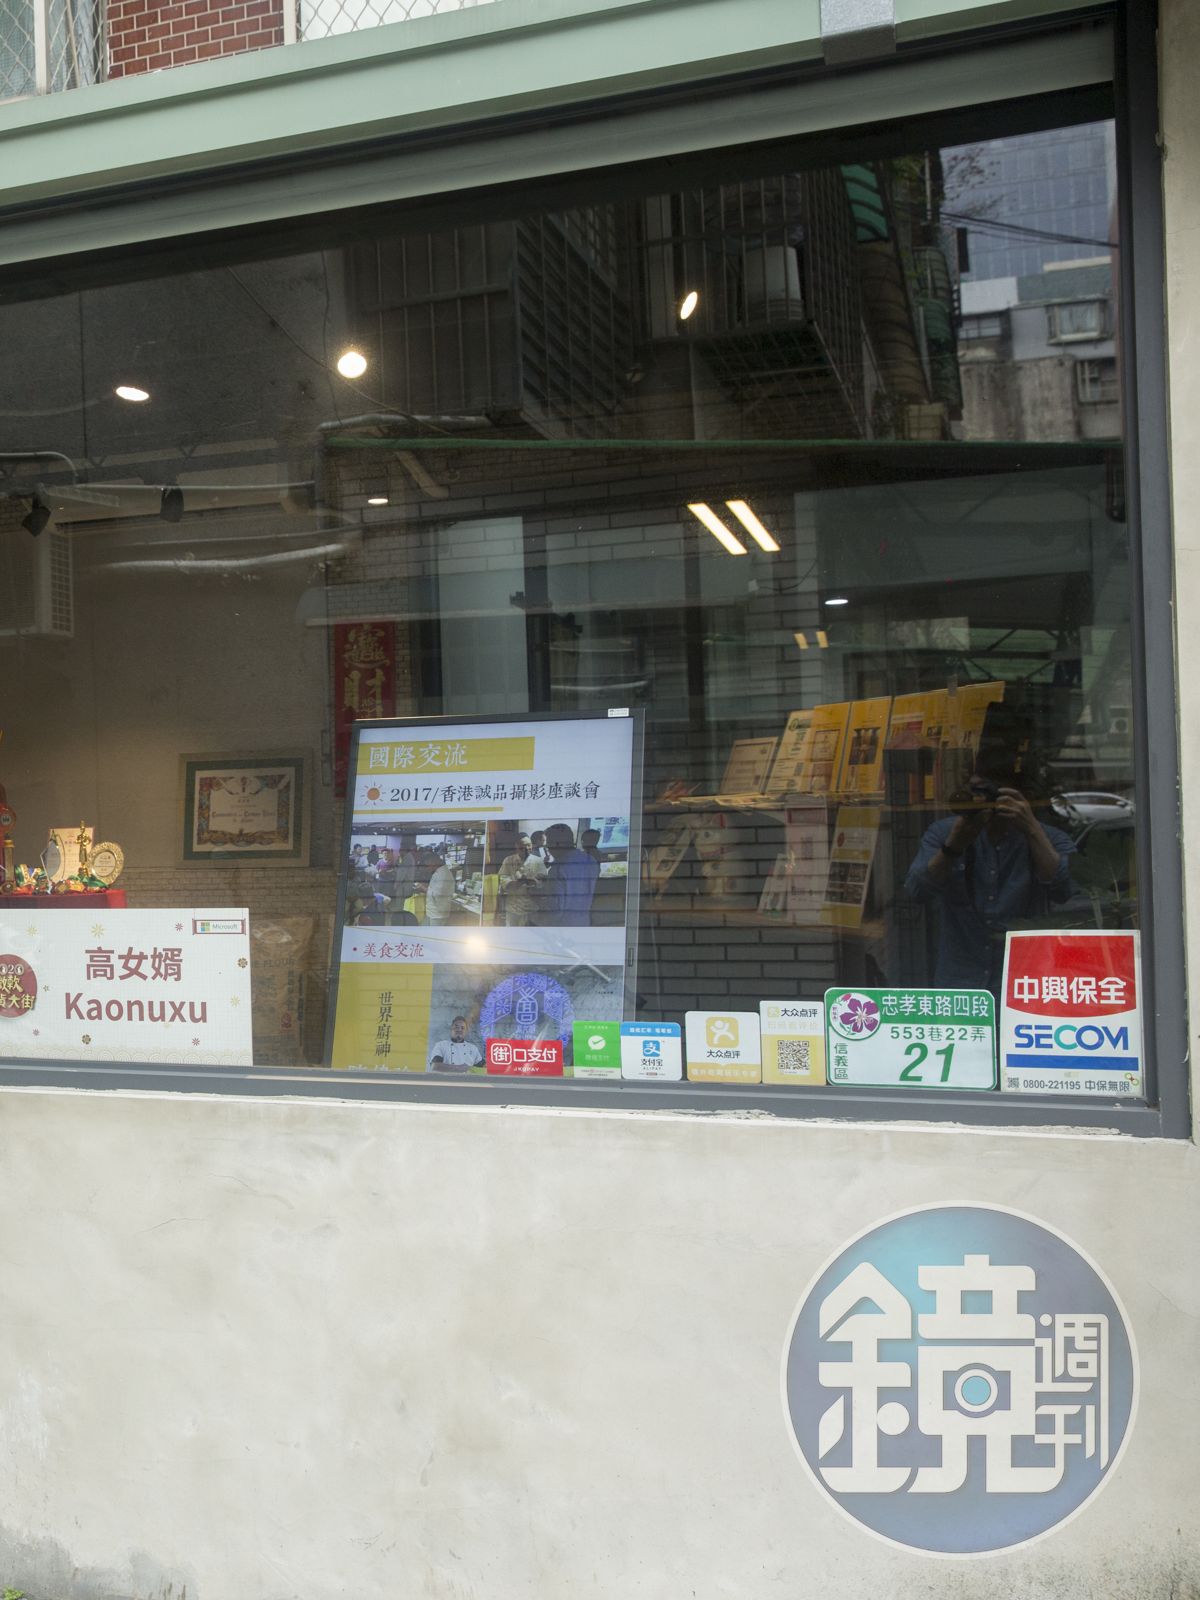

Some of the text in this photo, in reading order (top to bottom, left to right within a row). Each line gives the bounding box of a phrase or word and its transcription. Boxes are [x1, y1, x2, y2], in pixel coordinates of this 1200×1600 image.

[369, 743, 468, 769] 國際交流
[390, 780, 601, 805] 2017/香港誠品攝影座談會
[363, 941, 425, 959] 美食交流
[85, 946, 184, 982] 高女婿
[1013, 975, 1127, 1005] 中興保全
[64, 992, 208, 1024] Kaonuxu
[780, 1007, 818, 1018] 大众点评
[881, 994, 989, 1017] 忠孝東路四段
[890, 1026, 986, 1043] 553巷22弄
[1014, 1024, 1129, 1051] SECOM
[491, 1043, 557, 1065] 街口支付
[706, 1049, 741, 1059] 大众点评
[834, 1042, 849, 1080] 信義區
[899, 1042, 955, 1082] 21
[1023, 1079, 1081, 1090] 0800-221195
[1084, 1079, 1130, 1092] 中保無限
